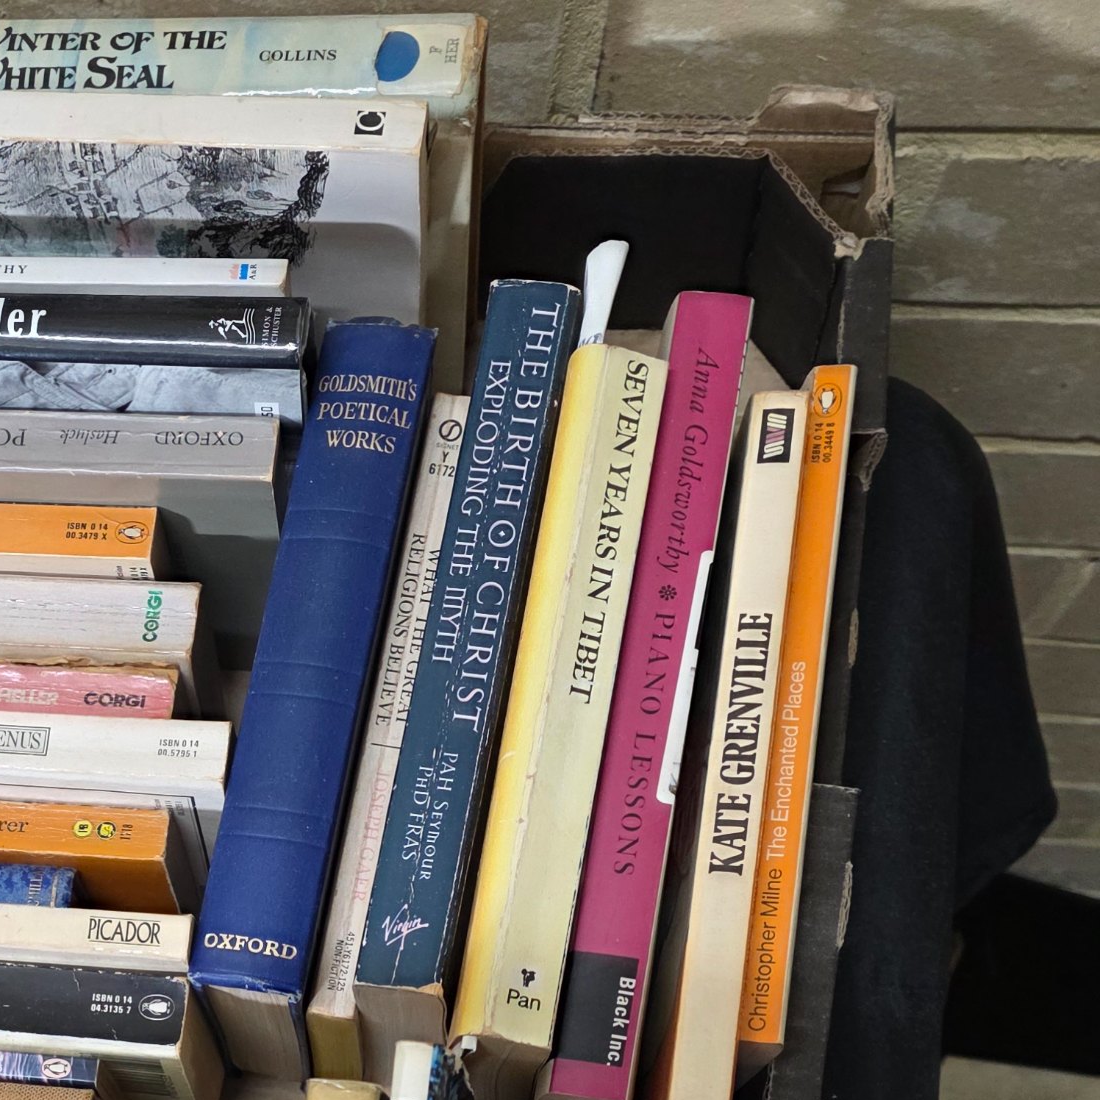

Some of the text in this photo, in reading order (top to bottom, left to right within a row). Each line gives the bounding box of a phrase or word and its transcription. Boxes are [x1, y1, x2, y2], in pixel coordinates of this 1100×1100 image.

[110, 31, 155, 51] OF
[163, 30, 228, 51] THE
[258, 49, 338, 62] COLLINS
[83, 56, 175, 90] SEAL
[318, 374, 417, 401] GOLDSMITH'S
[316, 401, 412, 429] POETICAL
[59, 429, 120, 445] Hasluck
[154, 430, 244, 446] OXFORD
[325, 429, 396, 454] WORKS
[428, 463, 455, 477] 6172
[452, 303, 561, 733] THE BIRTH OF CHRIST
[569, 359, 649, 704] SEVEN YEARS IN TIBET
[613, 347, 719, 876] Anna Goldsworthy PIANO LESSONS
[375, 533, 426, 726] RELIGIONS BELIEVE
[708, 613, 773, 876] KATE GRENVILLE
[747, 660, 807, 1032] Christopher Milne The Enchanted Places
[87, 919, 161, 945] PICADOR
[204, 933, 298, 960] OXFORD
[506, 989, 541, 1011] Pan
[606, 976, 636, 1068] Black Inc.
